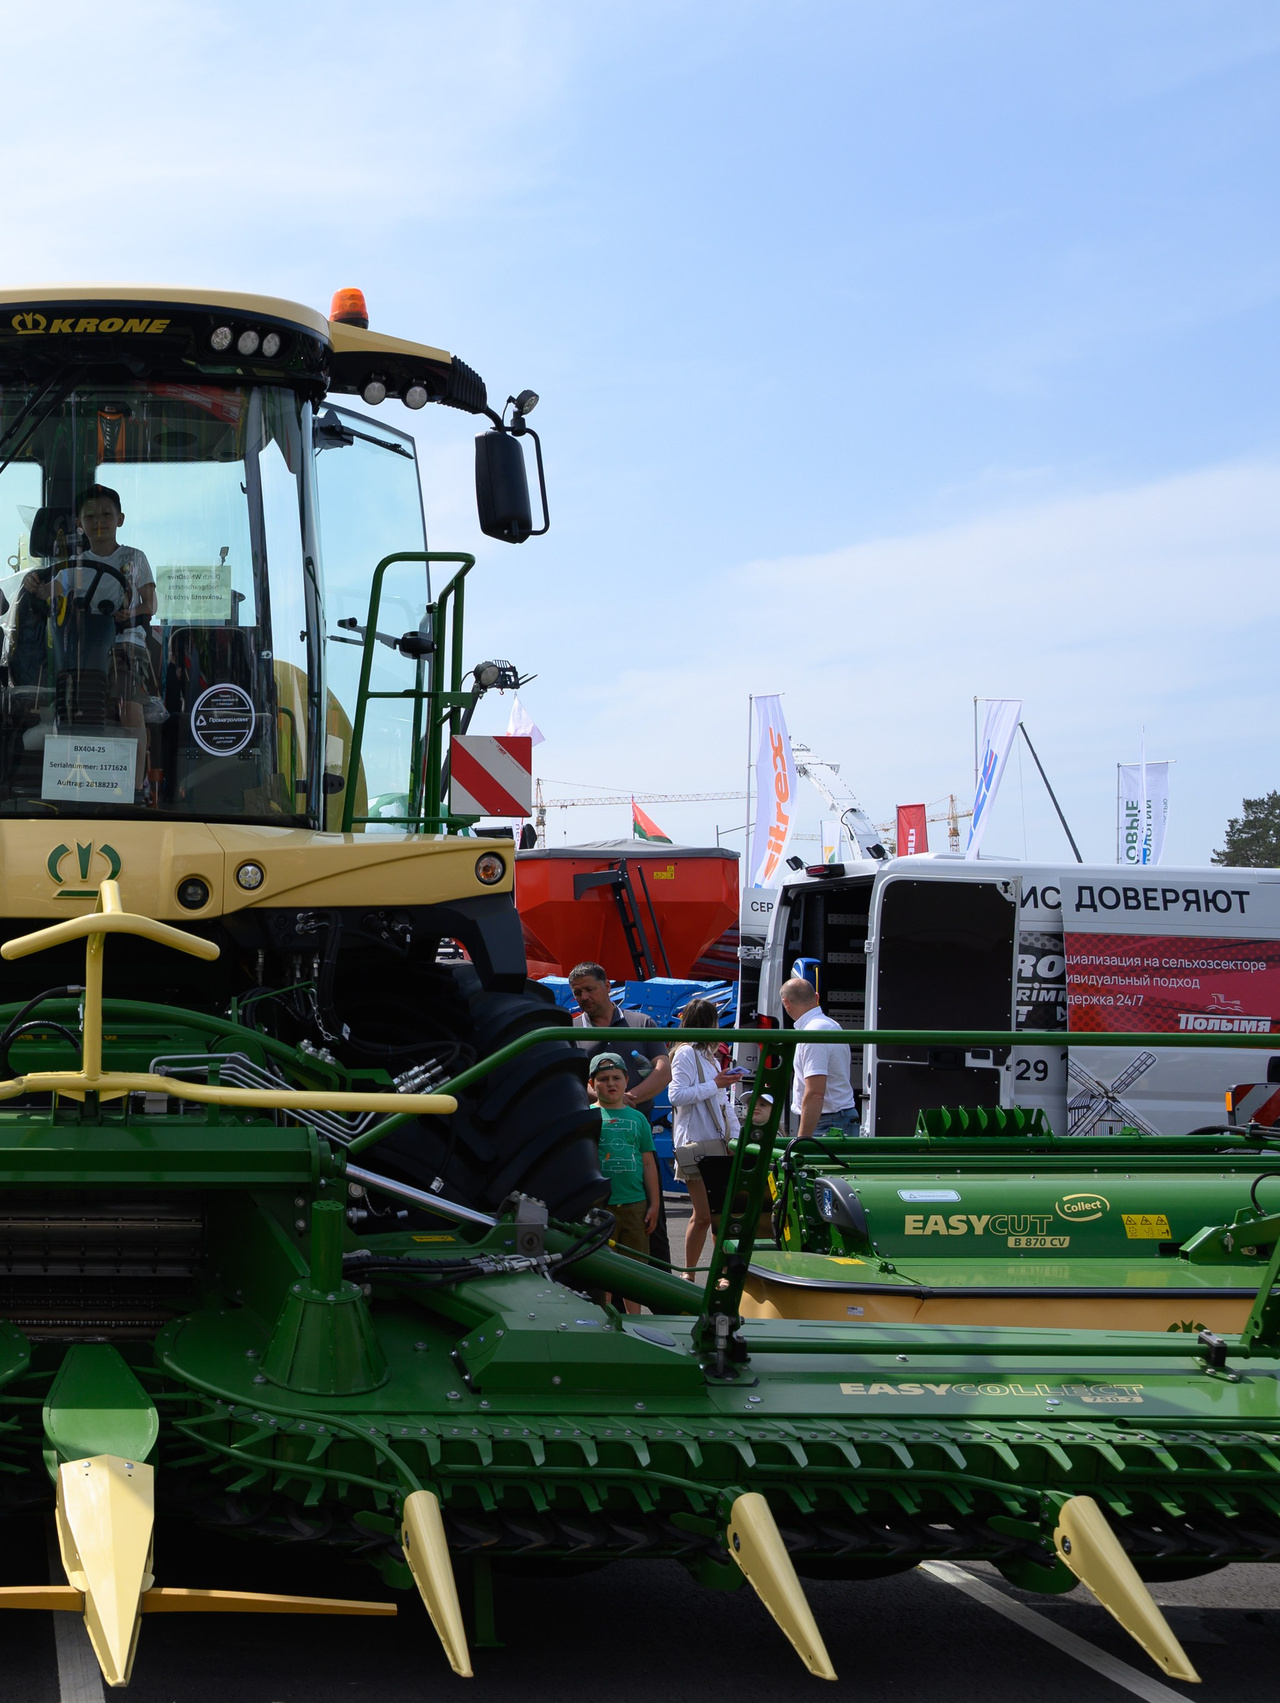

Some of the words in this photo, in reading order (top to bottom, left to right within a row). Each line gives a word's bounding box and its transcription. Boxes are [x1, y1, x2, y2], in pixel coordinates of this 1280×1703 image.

[49, 318, 171, 334] KRONE
[73, 745, 106, 753] BX404-25
[49, 761, 99, 771] Serialnummer:
[100, 764, 128, 772] 1171624
[57, 779, 85, 788] Auftrag:
[763, 726, 790, 881] sitrex
[1075, 885, 1250, 914] ДОВЕРЯЮТ
[1144, 957, 1160, 967] на
[1161, 957, 1267, 974] сельхозсекторе
[1153, 977, 1200, 990] подход
[1116, 994, 1144, 1007] 24/7
[1177, 1013, 1272, 1034] Полымя
[1063, 1199, 1102, 1213] Collect
[903, 1214, 1053, 1236] EASYCUT
[1013, 1237, 1022, 1248] B
[1024, 1237, 1047, 1248] 870
[1048, 1237, 1067, 1248] CV
[839, 1383, 1145, 1397] EASYCOLLECT
